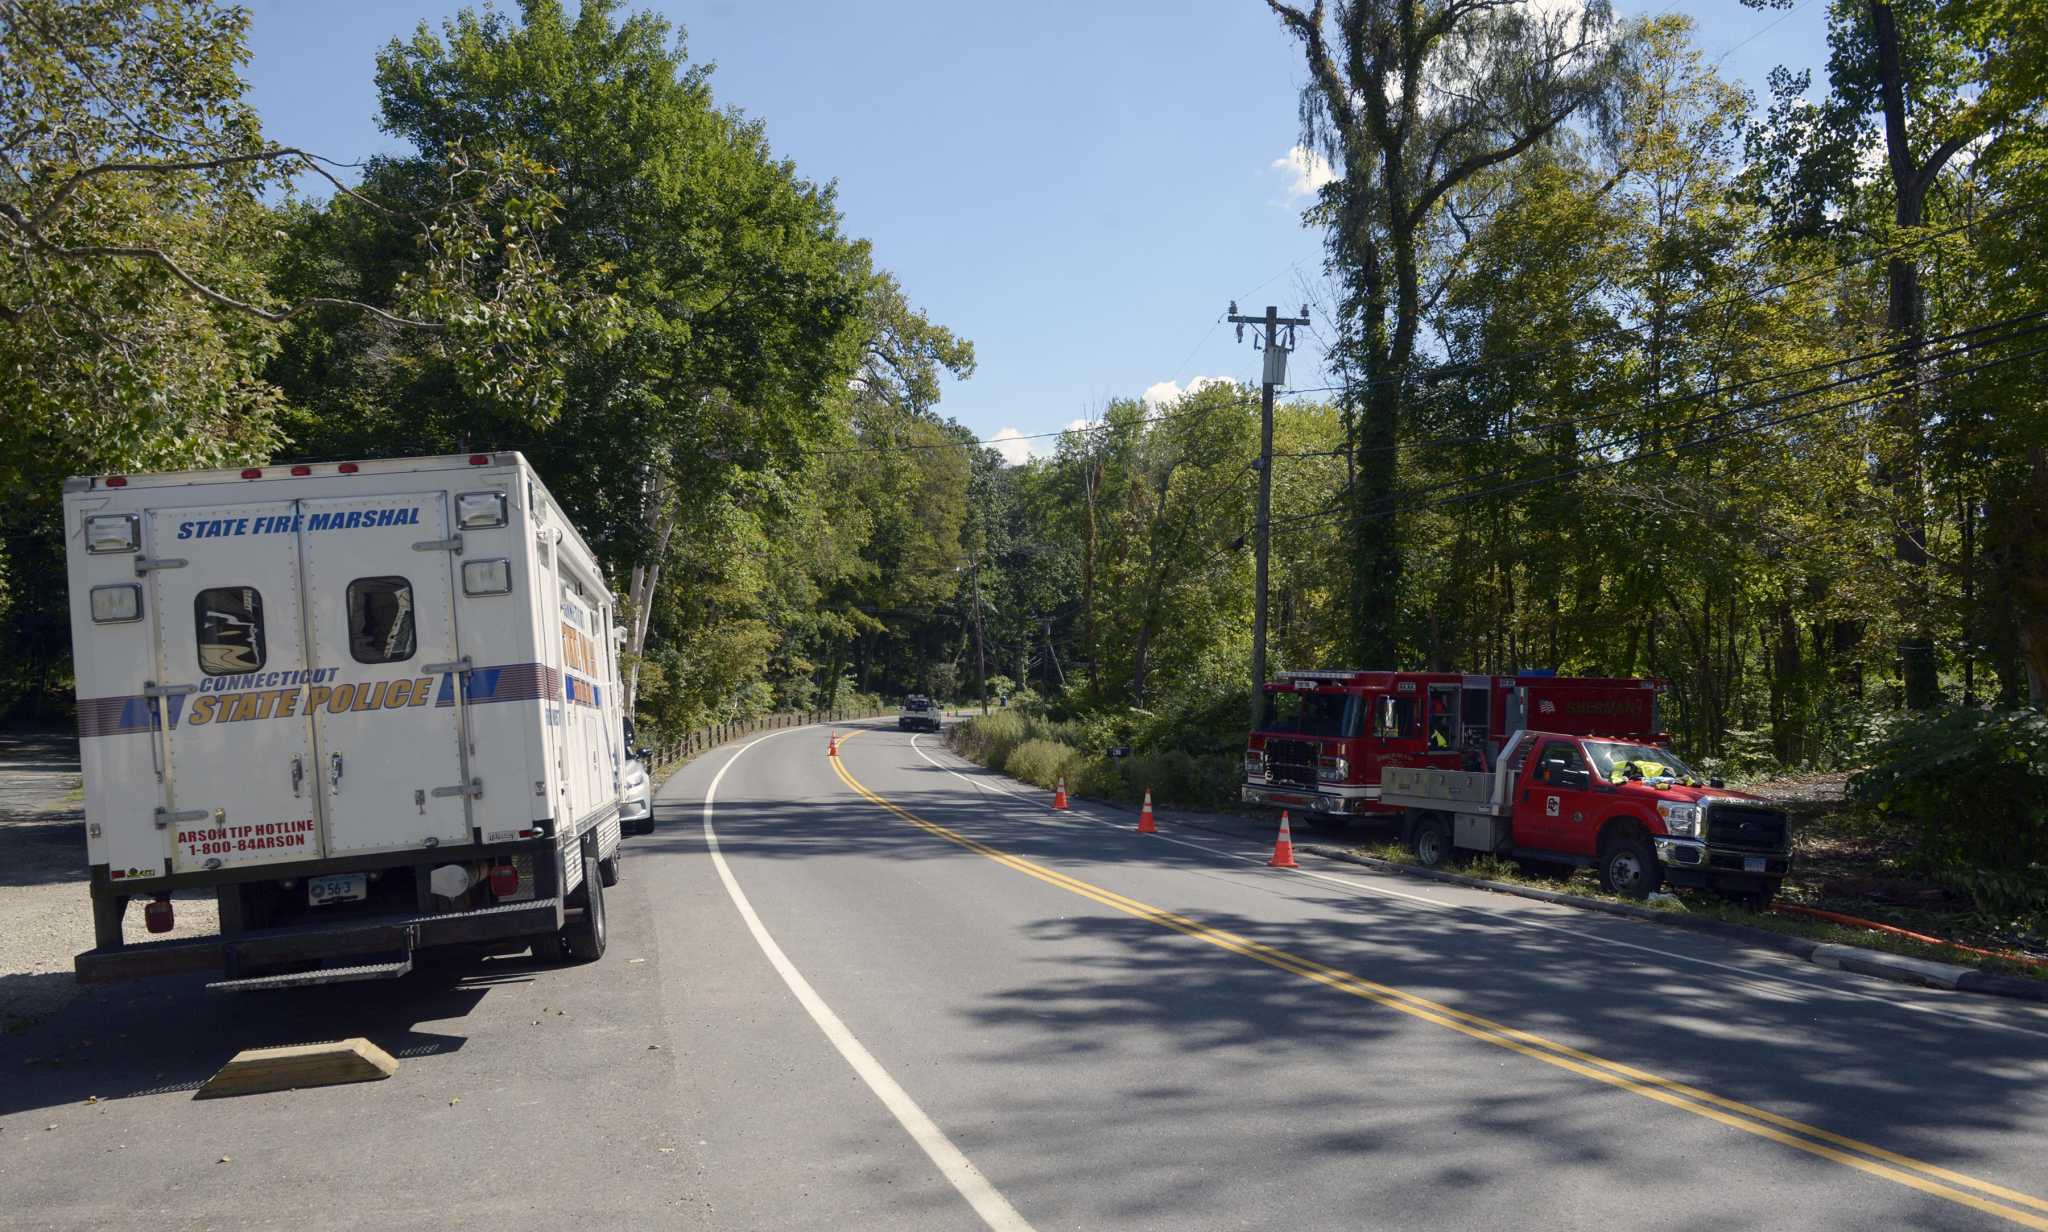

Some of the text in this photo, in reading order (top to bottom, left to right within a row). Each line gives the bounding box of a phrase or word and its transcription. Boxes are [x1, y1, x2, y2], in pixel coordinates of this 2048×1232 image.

[177, 508, 419, 540] STATE FIRE MARSHAL
[200, 667, 339, 693] CONNECTICUT
[188, 677, 434, 726] STATE POLICE
[178, 819, 314, 844] ARSON TIP HOTLINE
[189, 834, 305, 856] 1-800-84ARSON
